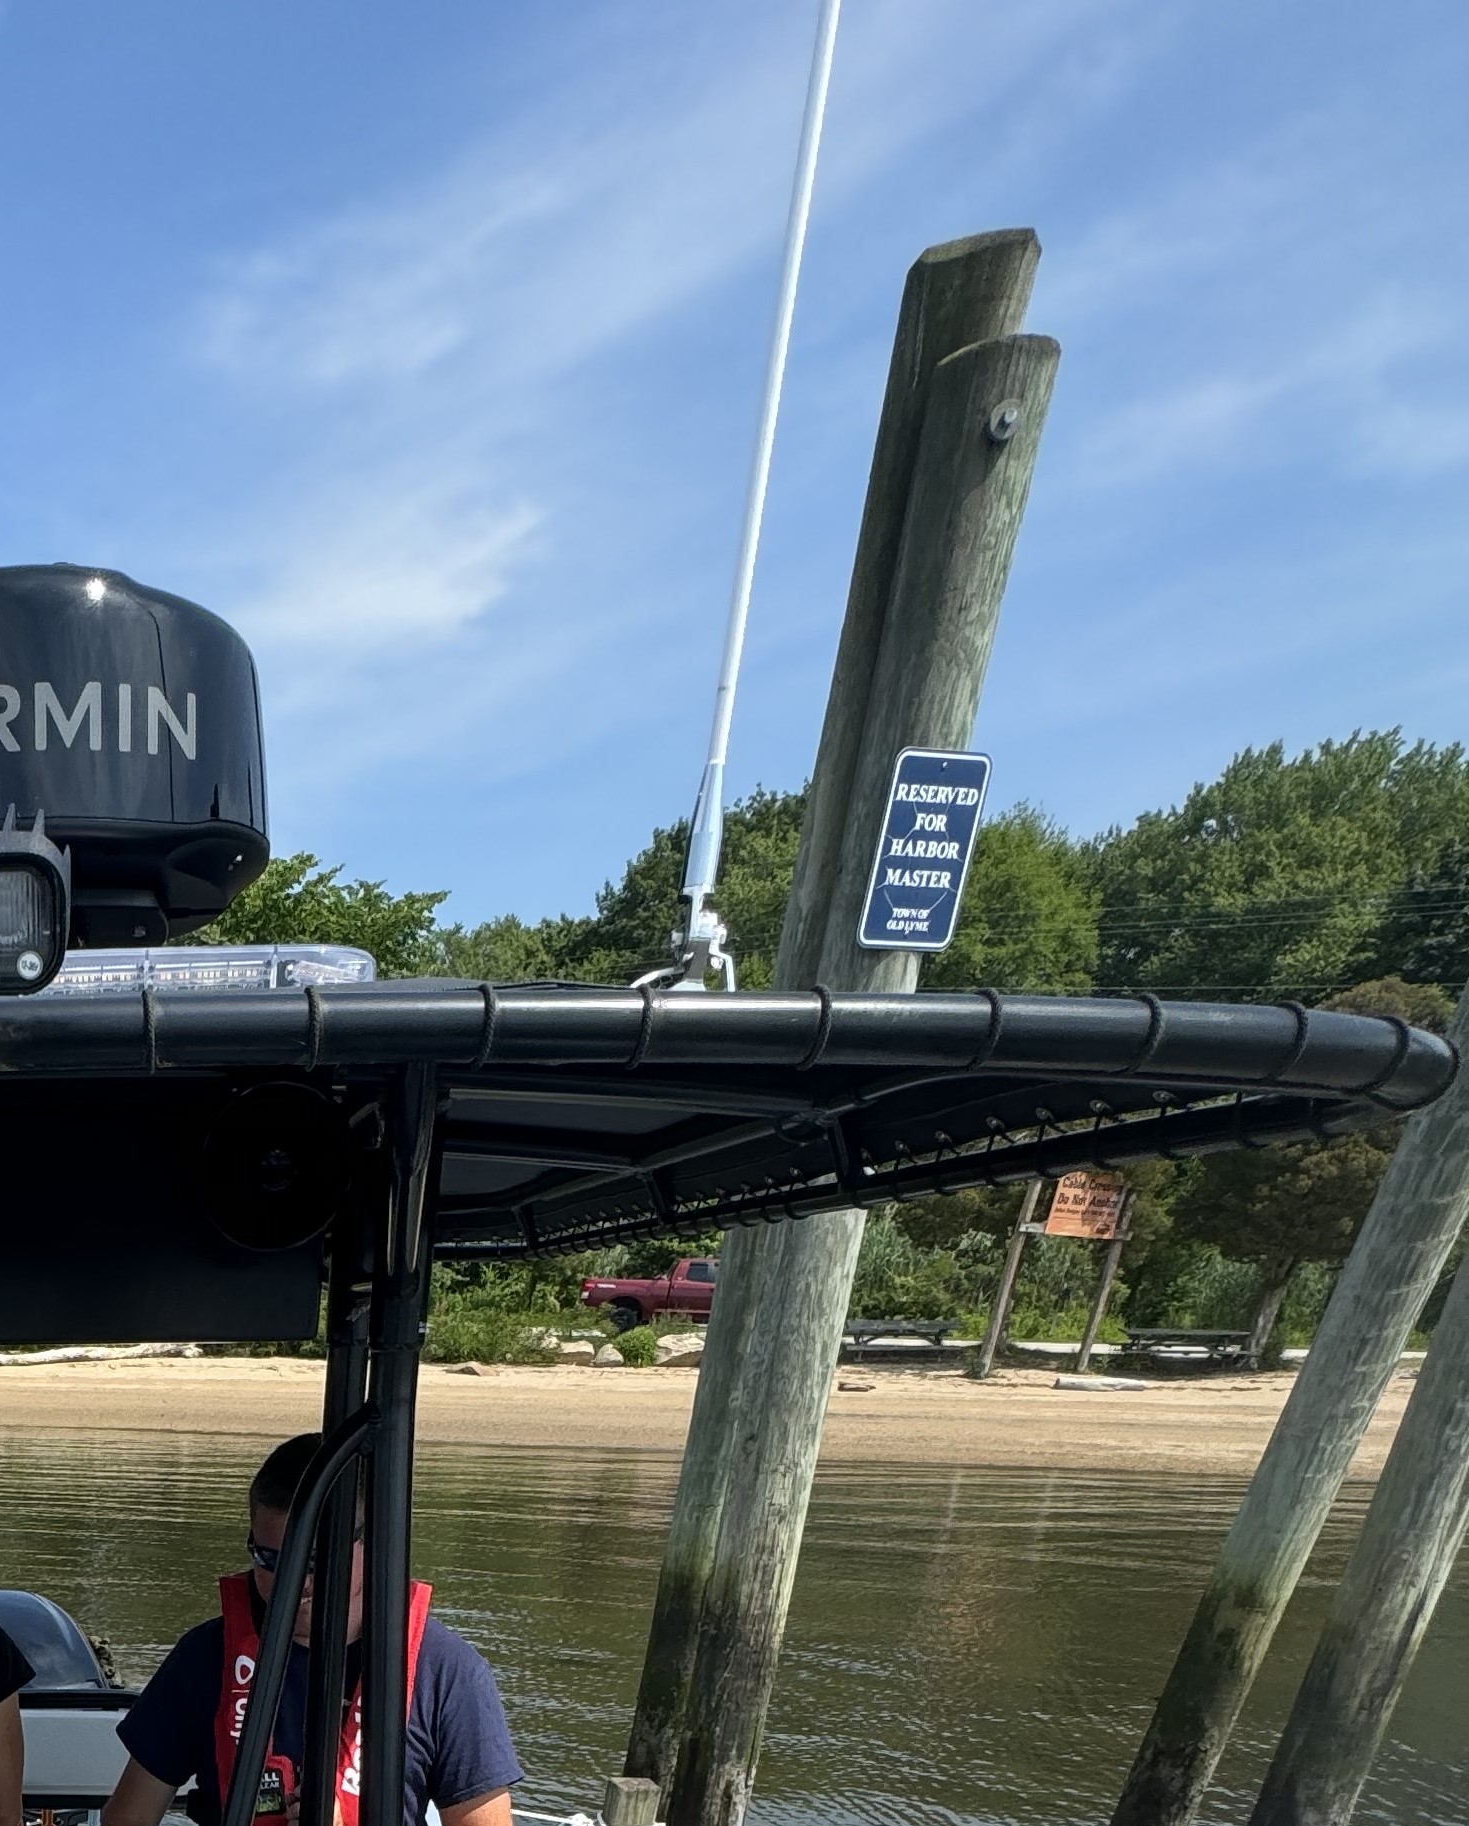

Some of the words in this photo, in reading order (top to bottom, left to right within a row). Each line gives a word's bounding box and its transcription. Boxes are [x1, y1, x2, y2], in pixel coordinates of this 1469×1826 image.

[896, 783, 979, 806] RESERVED
[914, 813, 947, 832] FOR
[890, 838, 960, 859] HARBOR
[885, 868, 952, 888] MASTER
[261, 1772, 279, 1782] LL
